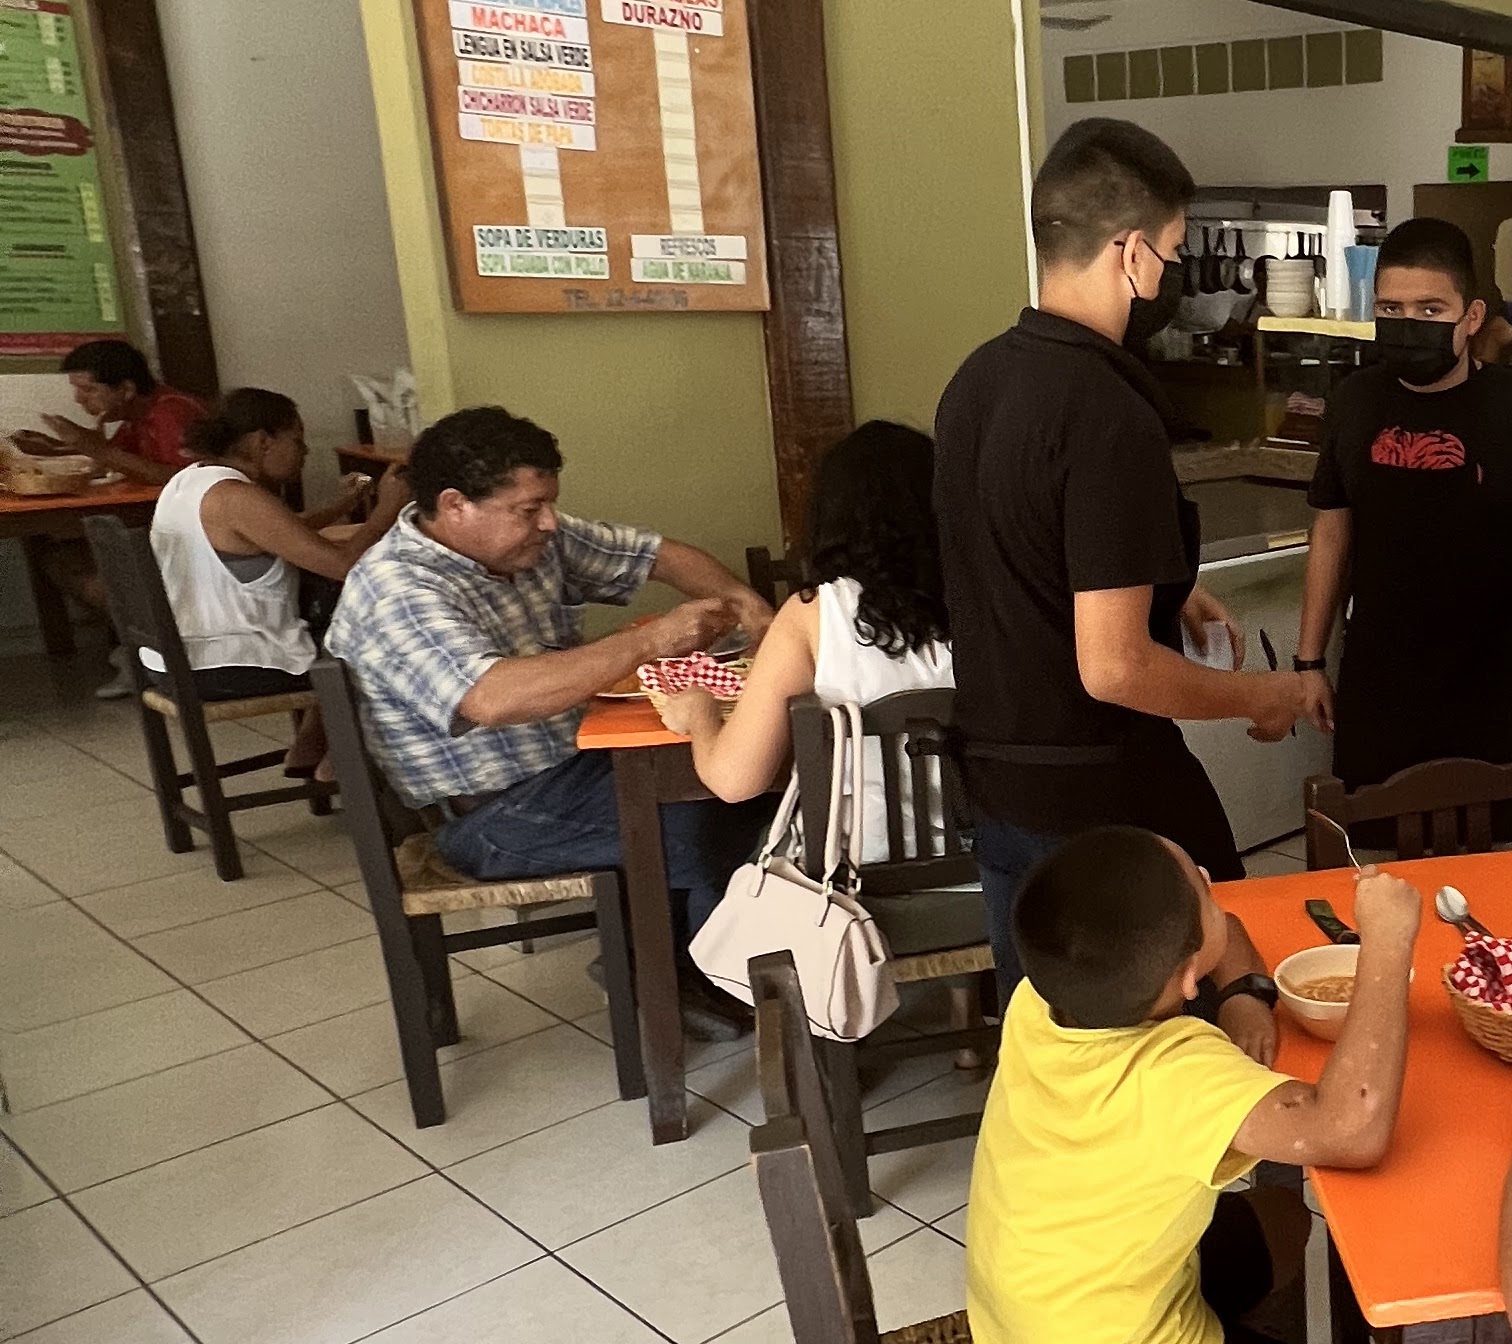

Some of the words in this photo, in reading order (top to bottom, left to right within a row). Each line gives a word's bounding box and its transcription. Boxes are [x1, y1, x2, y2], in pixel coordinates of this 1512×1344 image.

[471, 5, 567, 39] MACHACA
[621, 1, 704, 31] DURAZNO
[455, 32, 501, 56] LENGUA
[503, 38, 518, 60] EN
[520, 40, 554, 63] SALSA
[556, 44, 590, 68] VERDE
[462, 89, 527, 115] CHICHARRON
[530, 96, 560, 118] SALSA
[563, 100, 593, 122] VERDE
[477, 227, 513, 248] SOPA
[515, 227, 534, 248] DE
[535, 228, 604, 249] VERDURAS
[480, 253, 506, 273] SOPA
